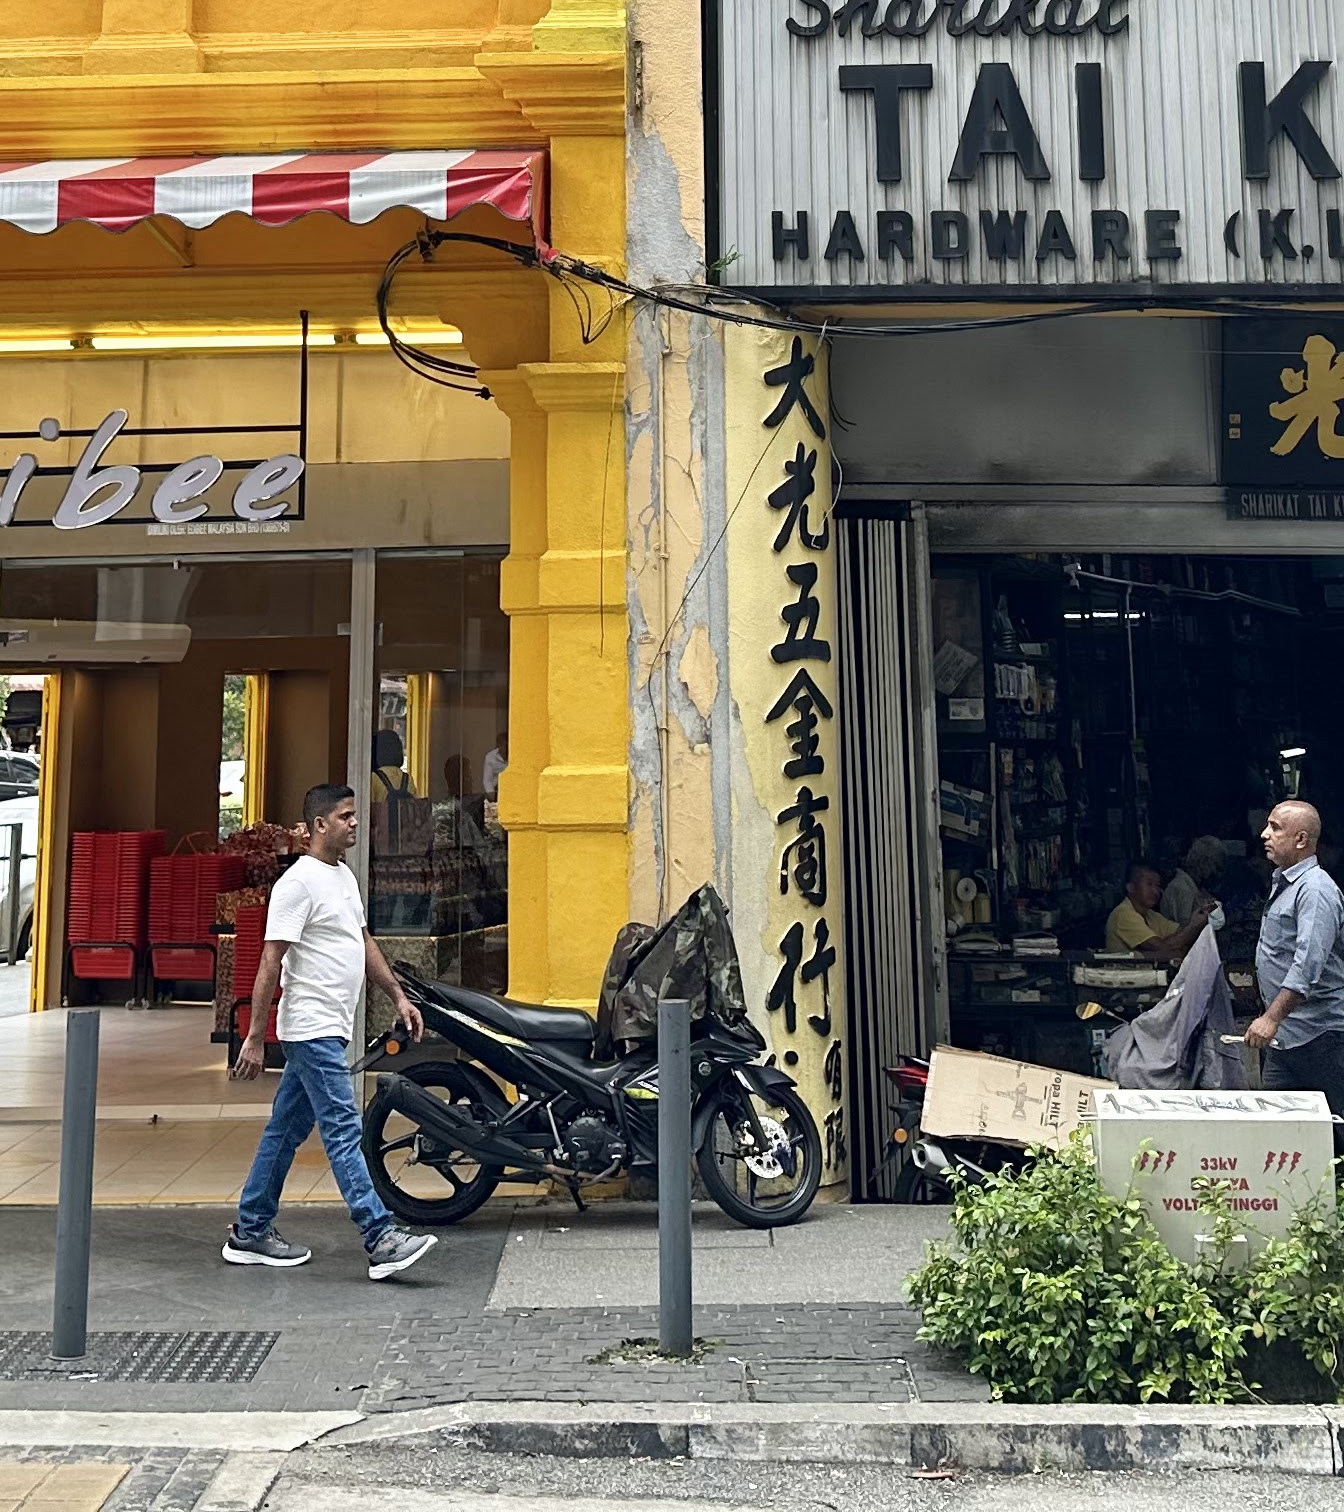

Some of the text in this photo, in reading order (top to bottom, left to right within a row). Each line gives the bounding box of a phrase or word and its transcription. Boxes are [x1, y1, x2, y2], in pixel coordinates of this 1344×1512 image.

[839, 62, 1105, 182] TAI
[771, 208, 1182, 262] HARDWARE
[1240, 494, 1299, 517] SHARIKAT
[1308, 494, 1327, 517] TAI
[1200, 1157, 1238, 1171] 33kV
[1162, 1198, 1221, 1211] VOLT
